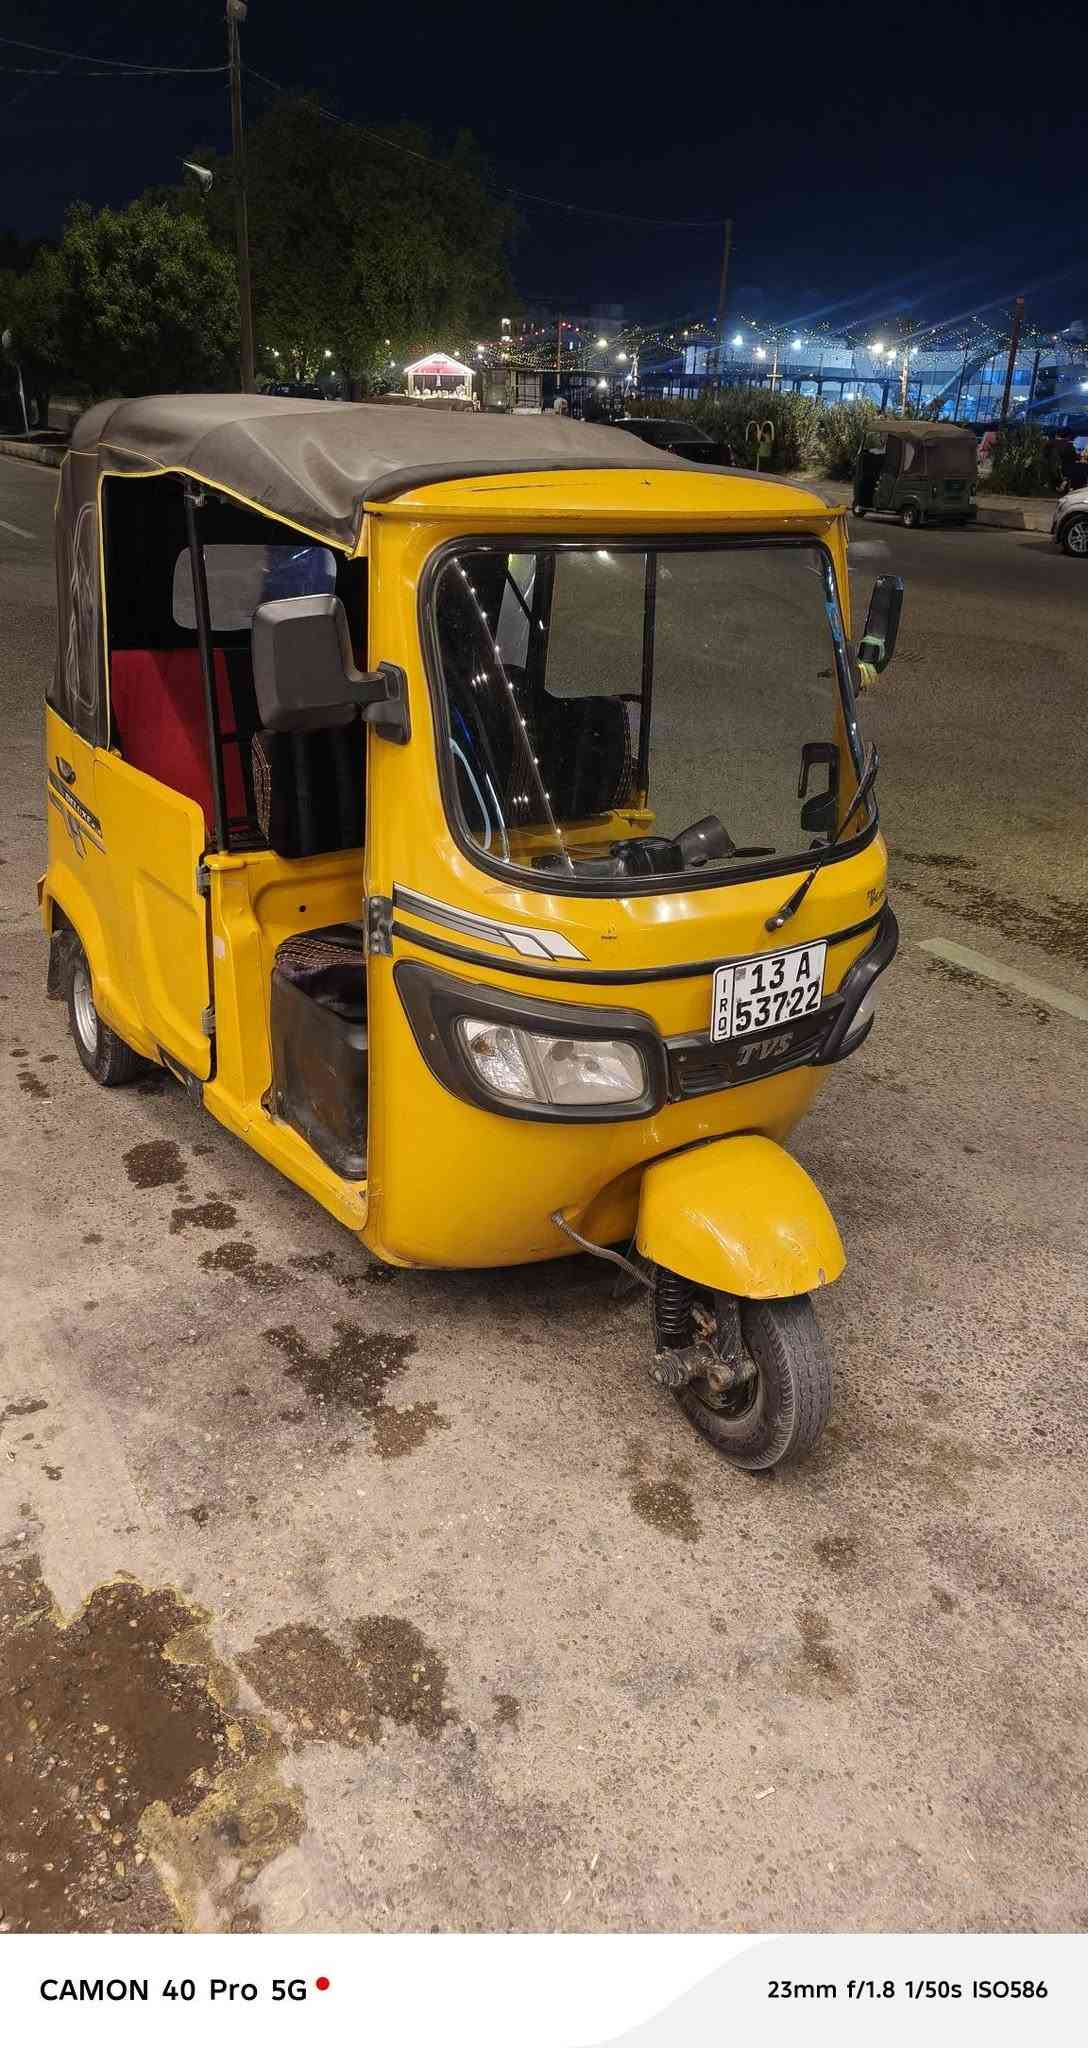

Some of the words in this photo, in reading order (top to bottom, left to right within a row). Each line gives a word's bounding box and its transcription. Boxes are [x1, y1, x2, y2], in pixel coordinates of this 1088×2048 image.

[750, 958, 786, 995] 13
[795, 951, 811, 982] A
[735, 980, 820, 1032] 53722
[736, 1033, 794, 1066] TVS
